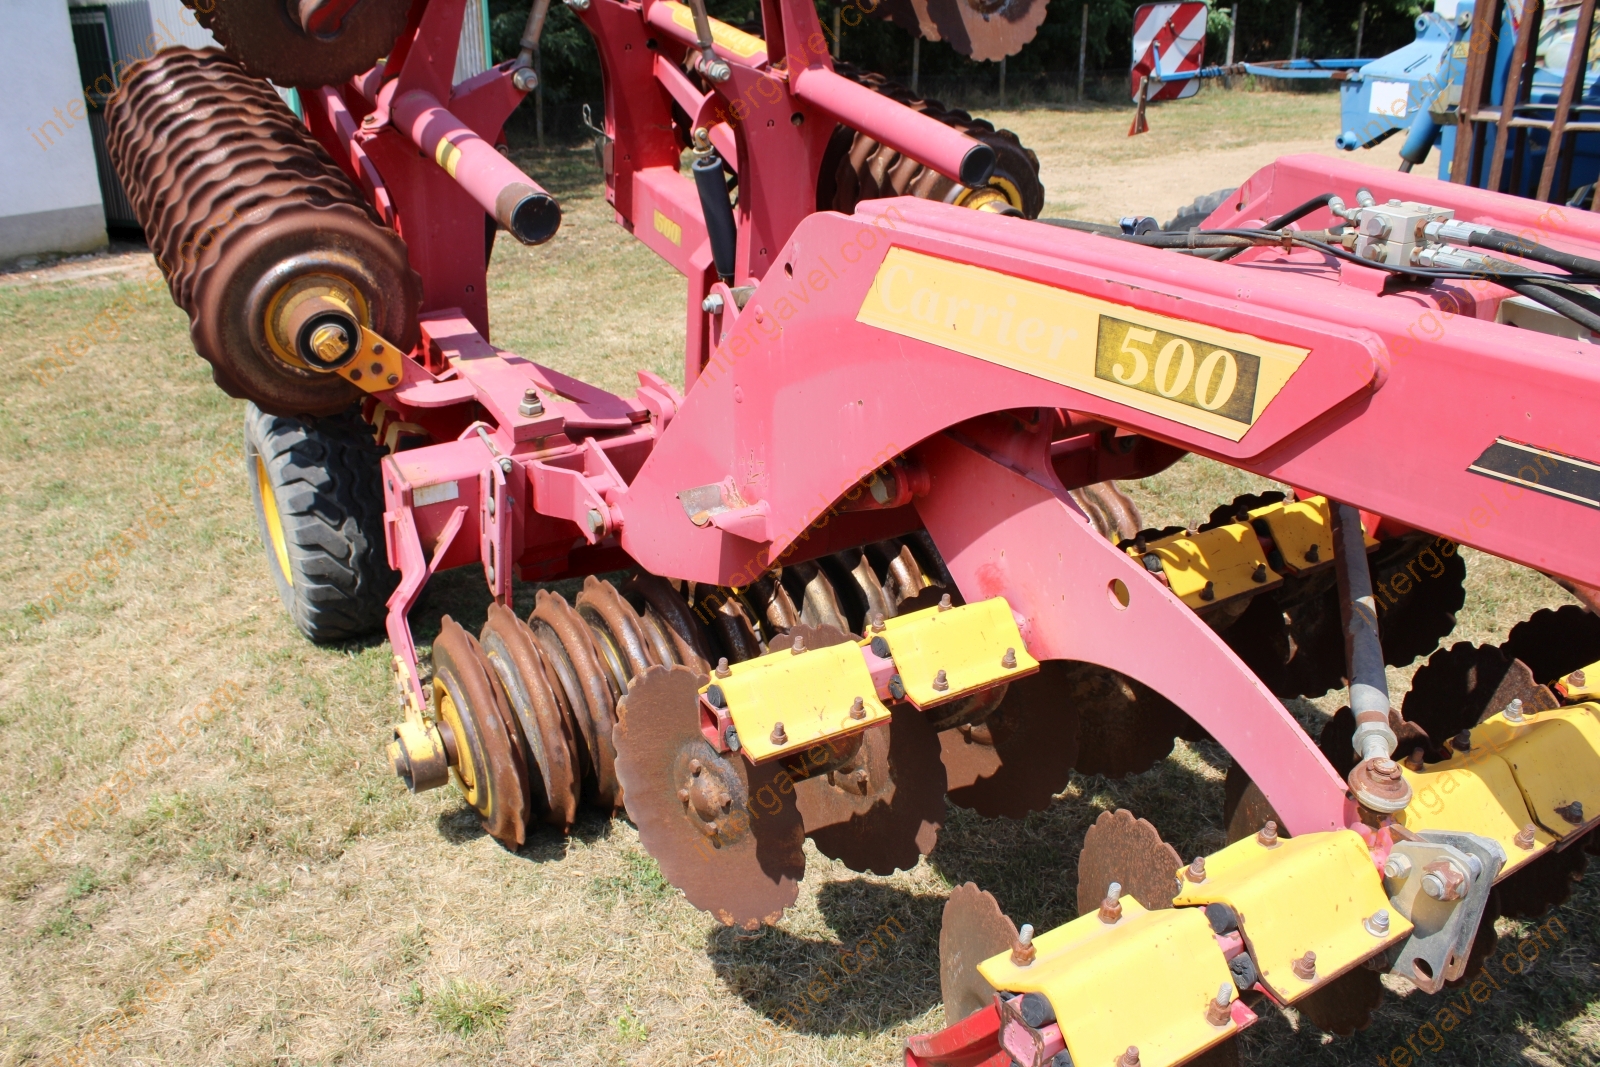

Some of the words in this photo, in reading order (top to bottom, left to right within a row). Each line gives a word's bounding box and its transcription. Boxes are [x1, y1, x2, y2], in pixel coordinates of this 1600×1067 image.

[656, 211, 678, 243] 500
[882, 264, 1078, 360] Carrier
[1112, 326, 1238, 411] 500
